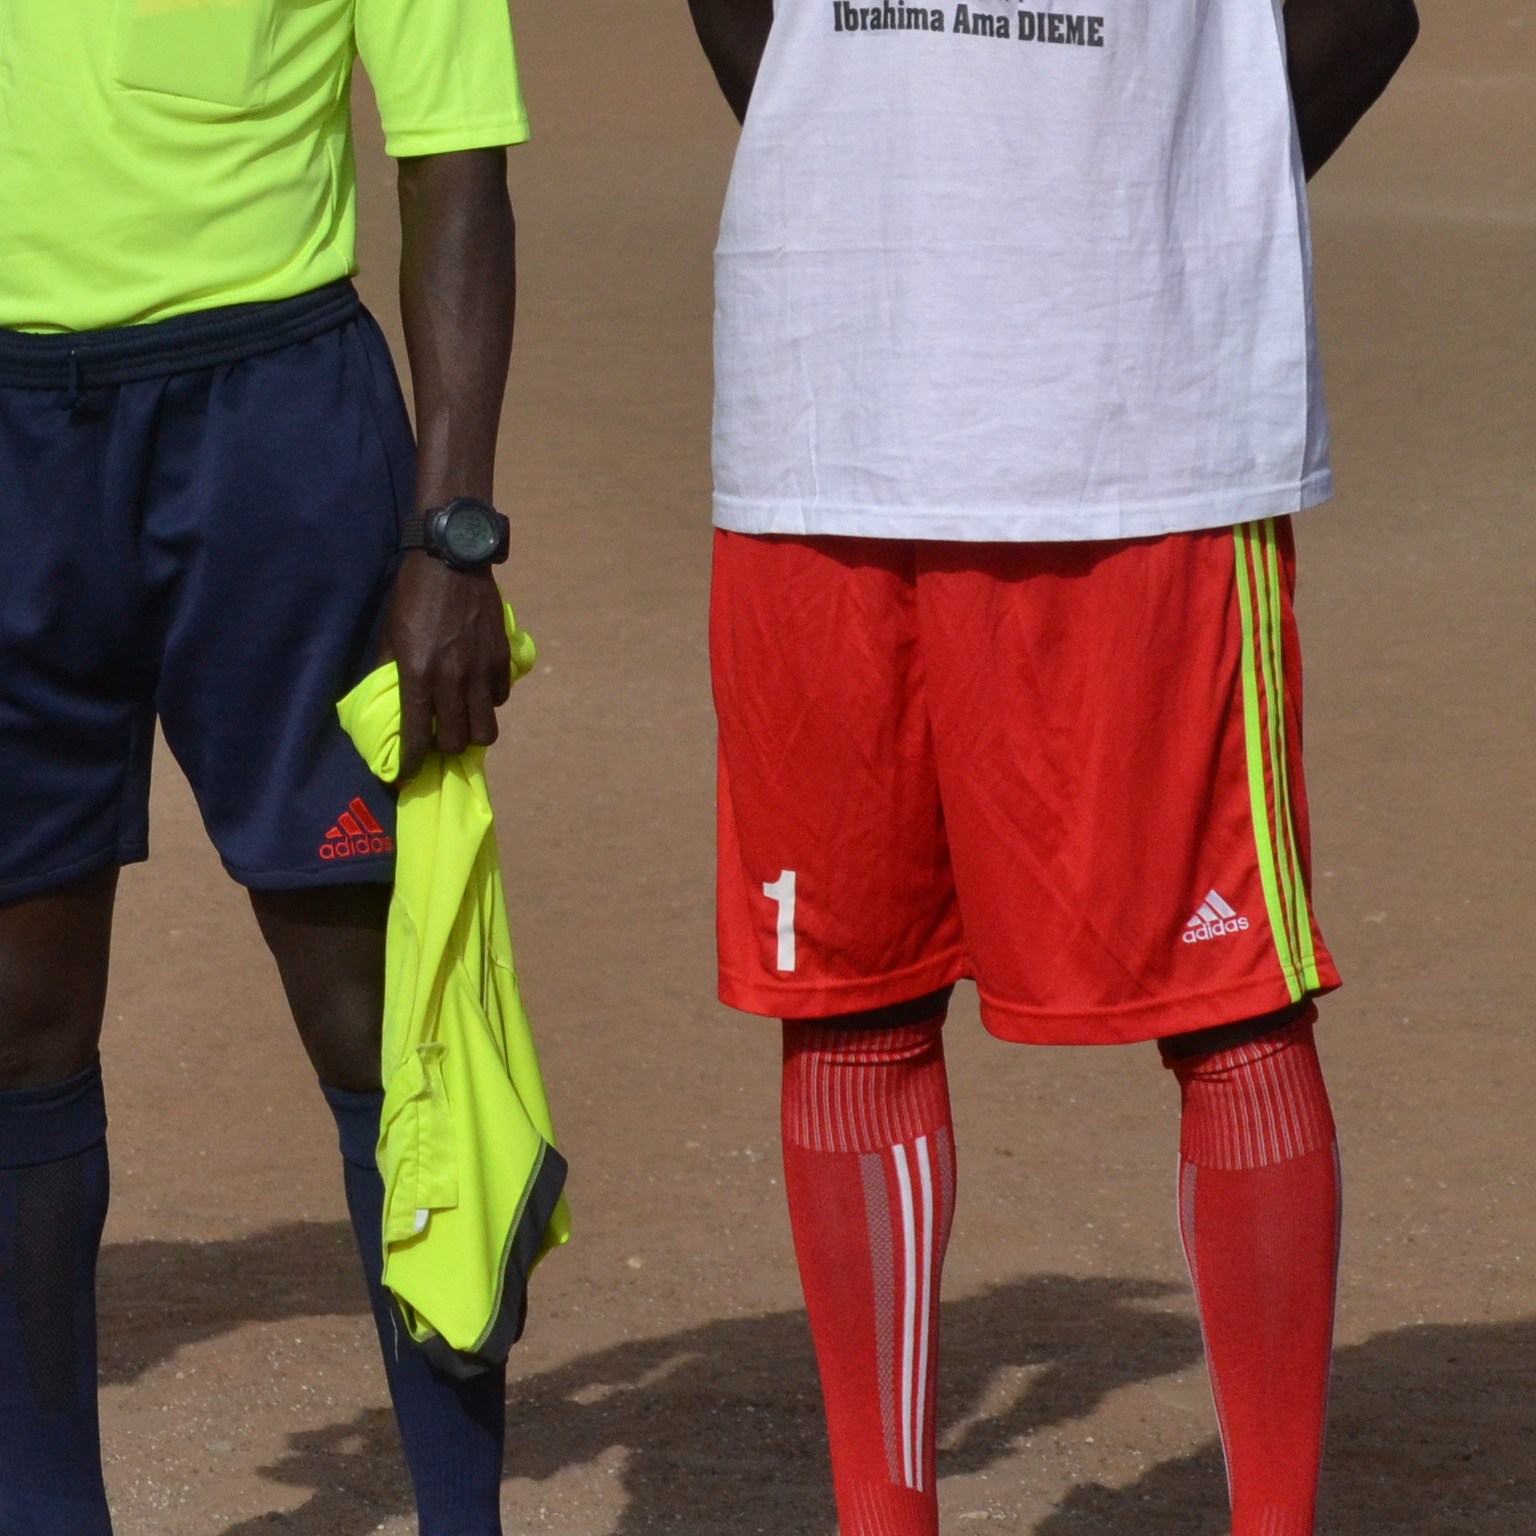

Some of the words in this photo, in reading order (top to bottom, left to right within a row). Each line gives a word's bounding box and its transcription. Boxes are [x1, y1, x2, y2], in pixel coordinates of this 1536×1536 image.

[832, 0, 945, 32] Ibrahima
[952, 3, 1010, 39] Ama
[1017, 10, 1105, 47] DIEME
[319, 832, 393, 860] adidas
[762, 869, 796, 972] 1
[1181, 916, 1250, 944] adidas
